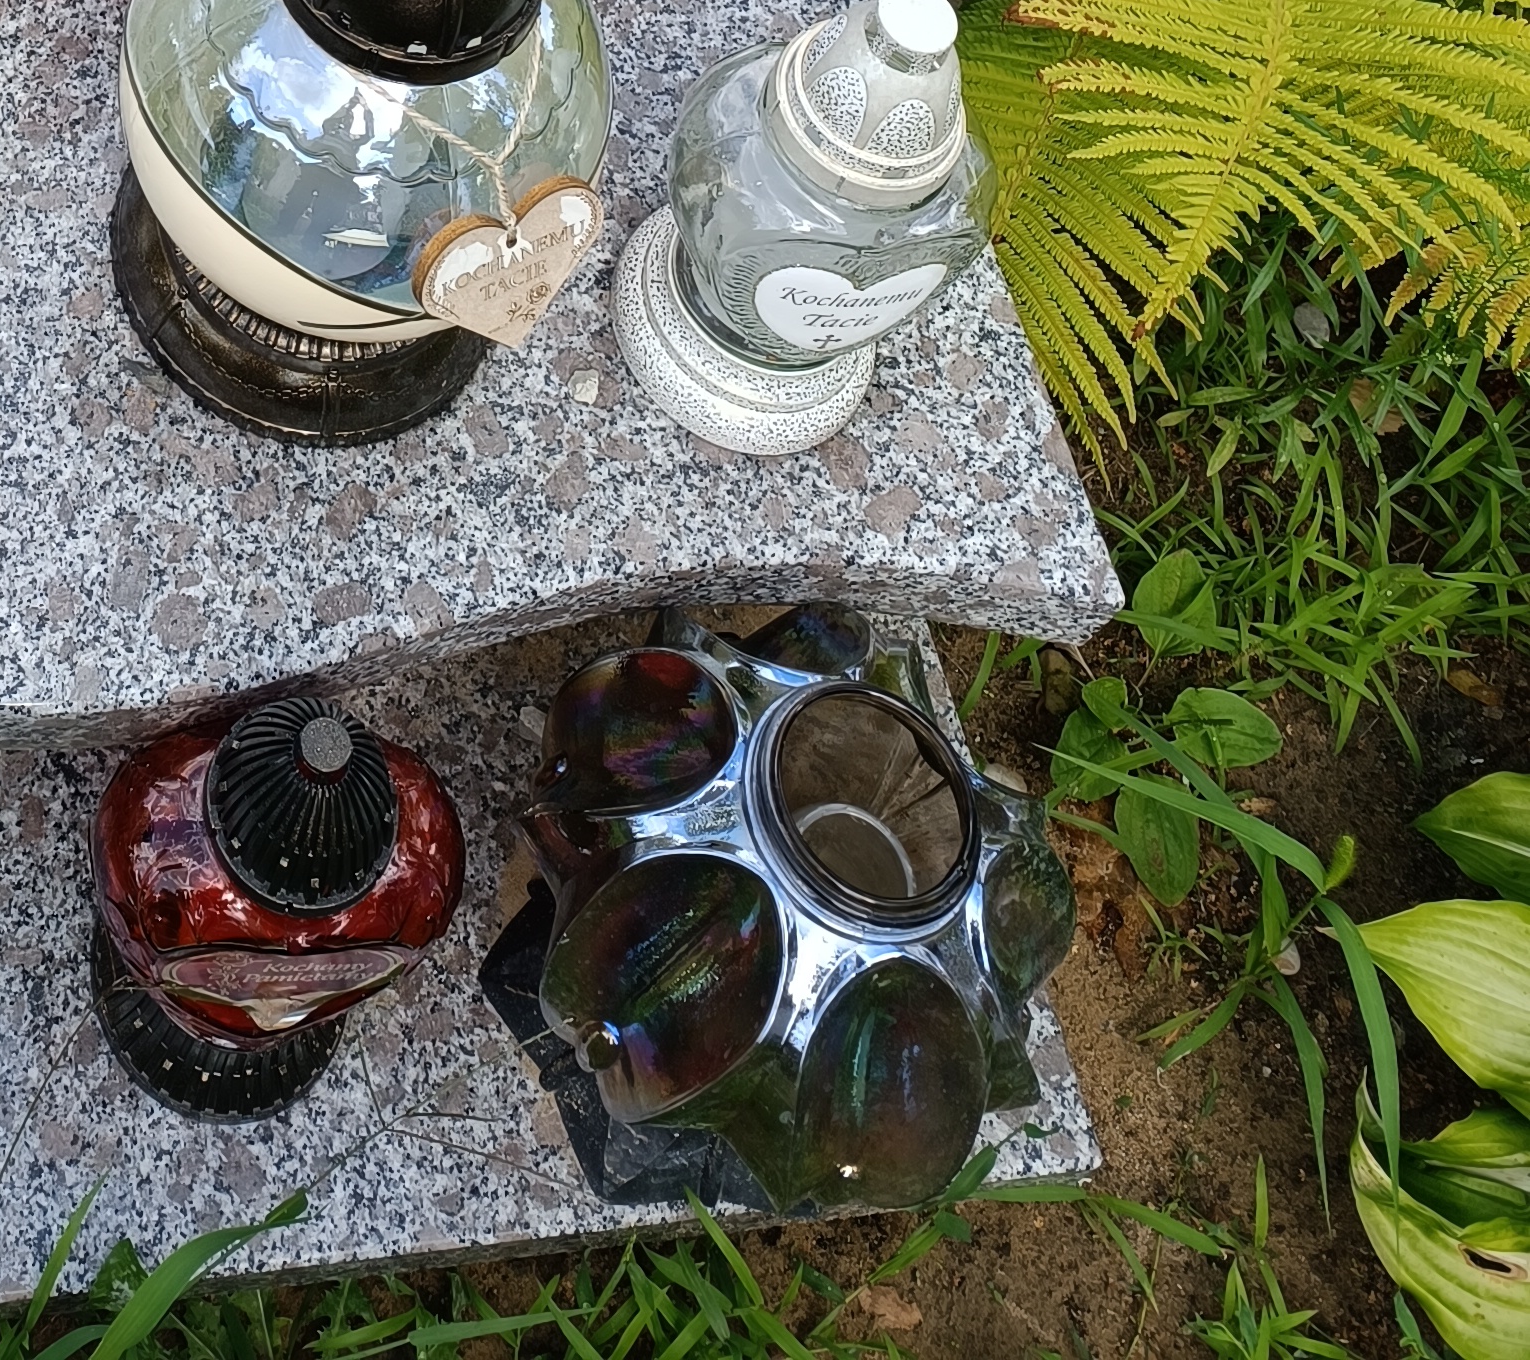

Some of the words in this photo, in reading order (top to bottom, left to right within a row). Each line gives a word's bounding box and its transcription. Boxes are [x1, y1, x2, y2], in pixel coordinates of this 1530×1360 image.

[440, 219, 586, 298] KOCHANEMU
[479, 259, 549, 302] TACIE
[779, 286, 925, 309] Kochanemu
[801, 313, 879, 329] Tacie
